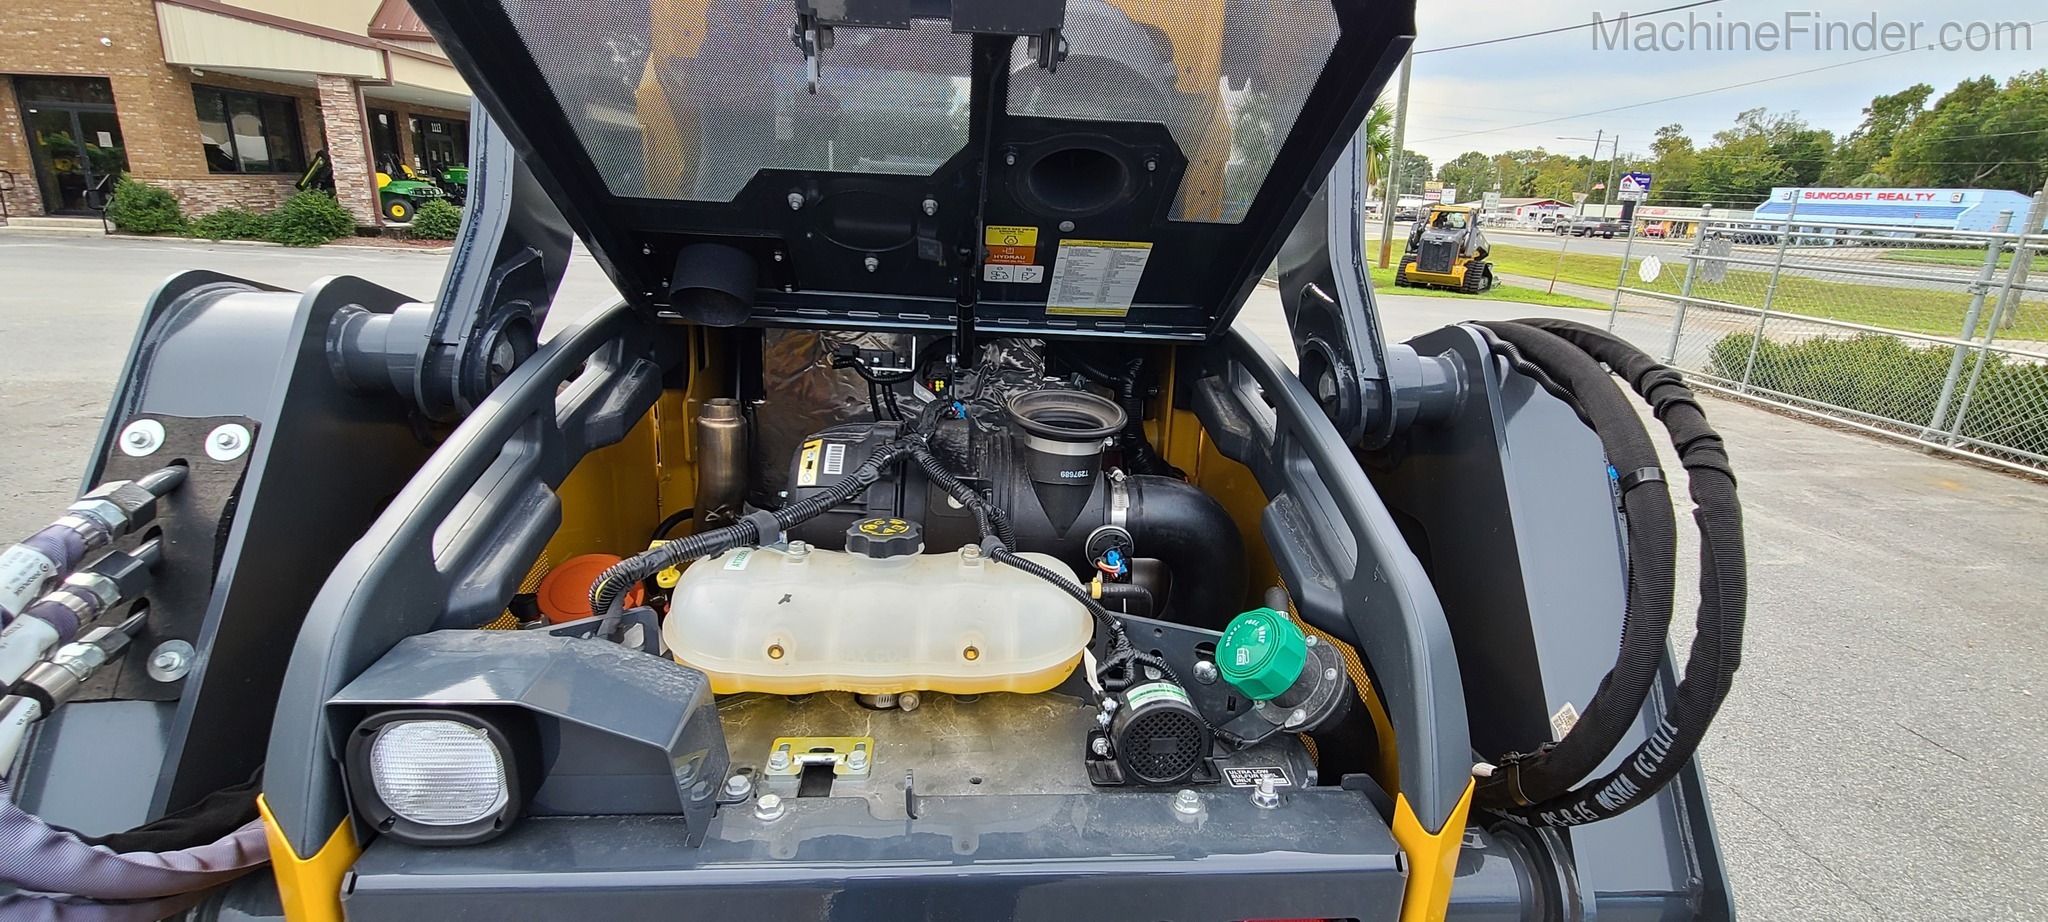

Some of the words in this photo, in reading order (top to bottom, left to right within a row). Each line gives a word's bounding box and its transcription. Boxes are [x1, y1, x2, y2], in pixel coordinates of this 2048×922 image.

[1804, 191, 1873, 201] SUNCOAST
[1877, 192, 1936, 202] REALTY
[1594, 773, 1641, 811] MSHA
